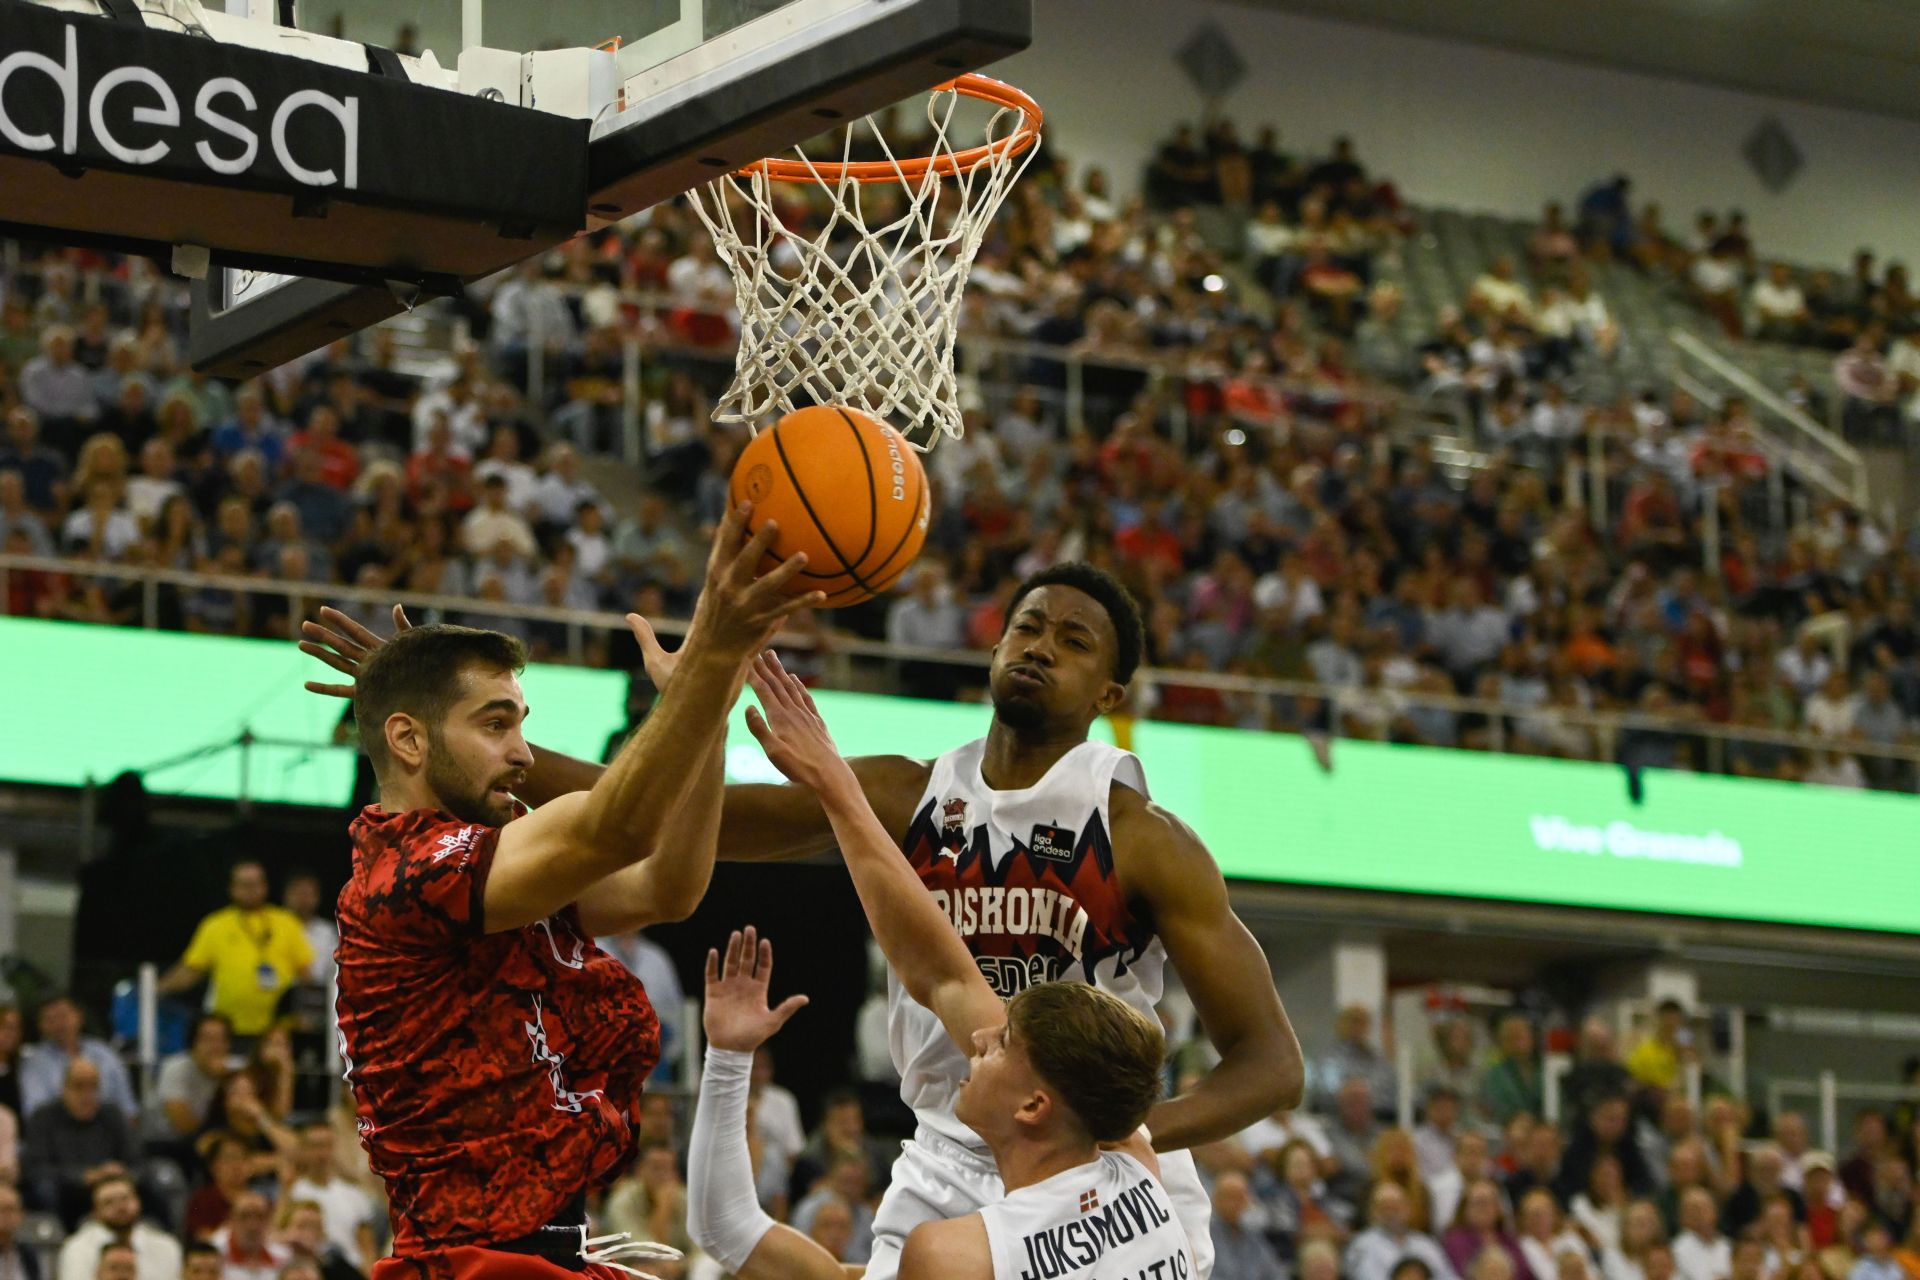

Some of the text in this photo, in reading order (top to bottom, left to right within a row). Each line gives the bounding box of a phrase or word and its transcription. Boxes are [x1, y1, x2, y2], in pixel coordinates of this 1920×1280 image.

[0, 24, 359, 189] desa
[1034, 833, 1052, 846] liga
[1033, 843, 1071, 858] endesa
